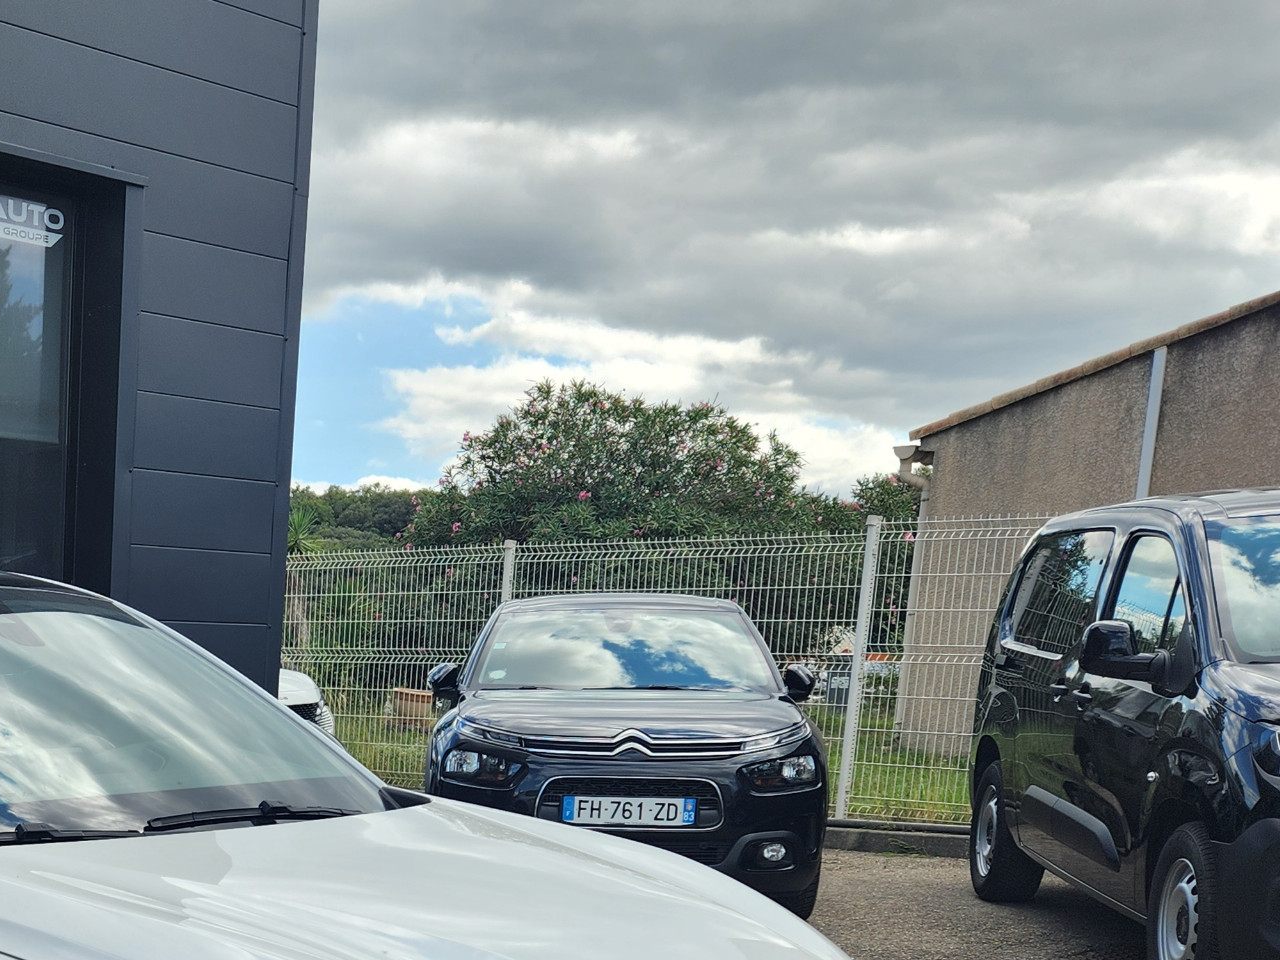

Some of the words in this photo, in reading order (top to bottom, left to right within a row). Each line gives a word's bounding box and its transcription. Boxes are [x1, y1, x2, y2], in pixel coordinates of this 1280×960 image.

[3, 226, 50, 244] GROUPE
[577, 799, 679, 821] FH-761-ZD
[683, 811, 695, 822] 83
